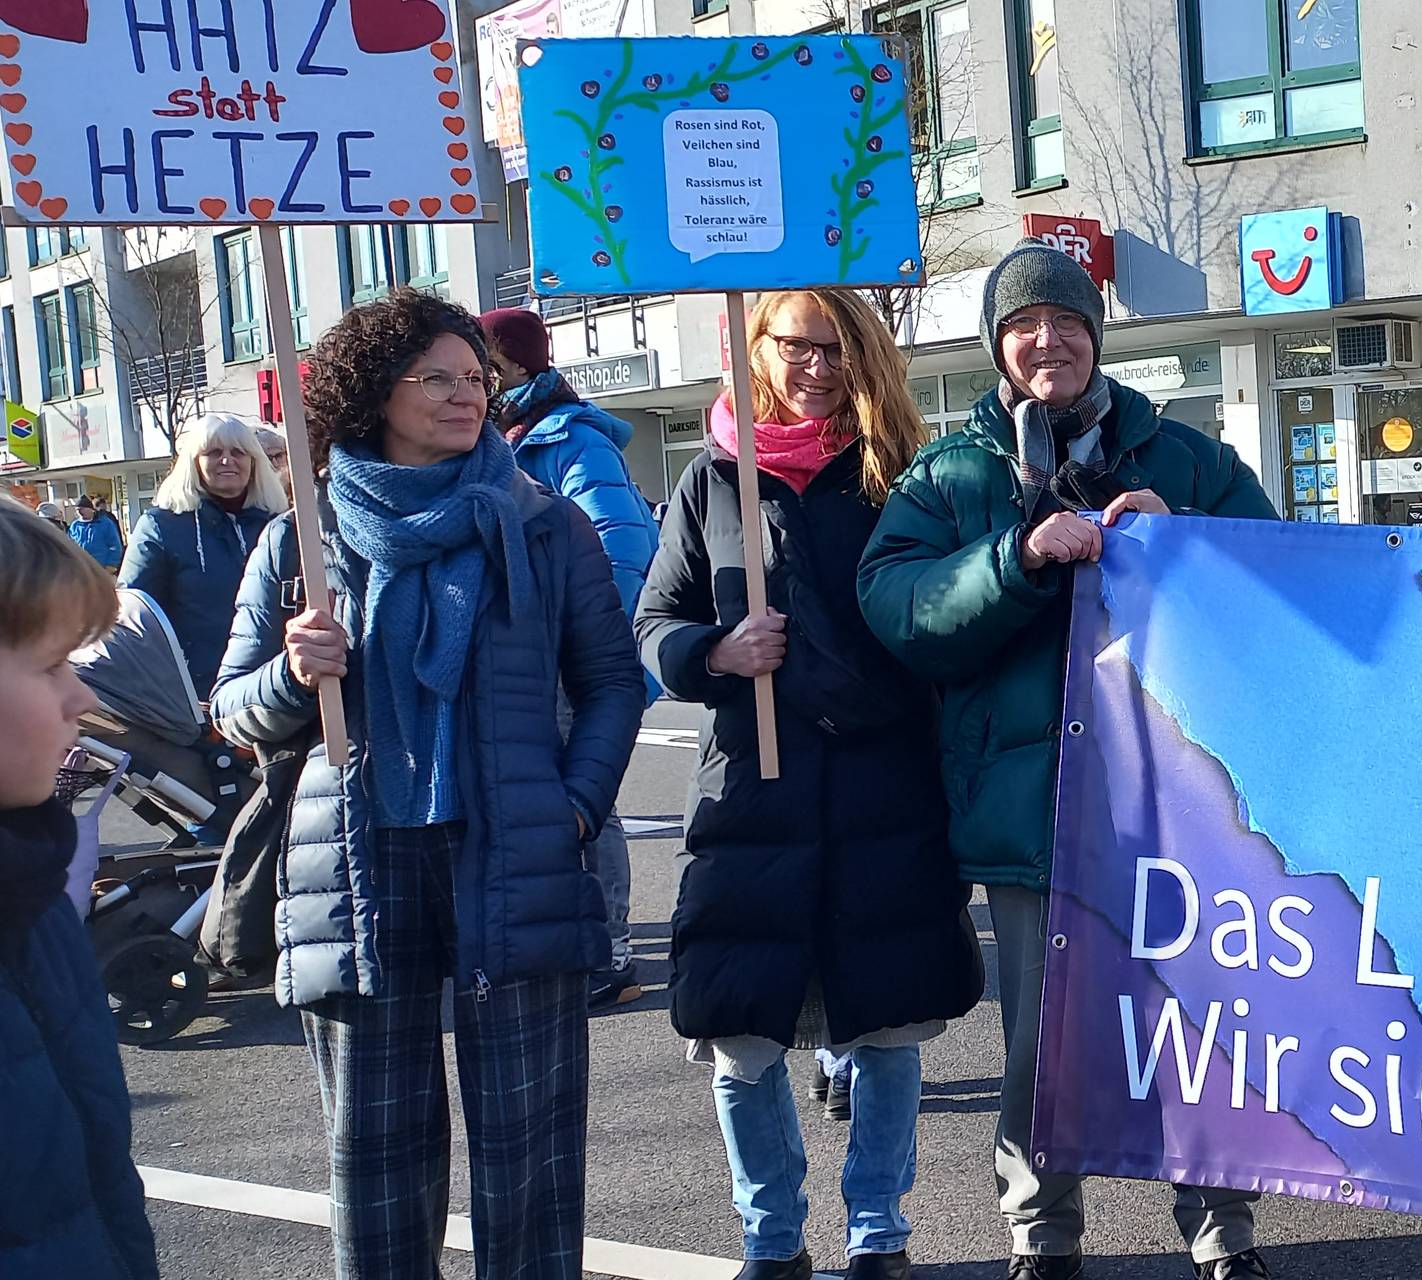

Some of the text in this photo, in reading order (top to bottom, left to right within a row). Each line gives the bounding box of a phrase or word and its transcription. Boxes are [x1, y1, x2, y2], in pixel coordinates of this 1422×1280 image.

[152, 76, 286, 123] statt
[675, 119, 765, 131] Rosen sind Rot,
[682, 139, 760, 150] Veilchen sind
[708, 157, 737, 169] Blau,
[86, 125, 383, 215] HETZE
[685, 177, 763, 188] Rassismus ist
[700, 195, 750, 207] hässlich,
[684, 214, 768, 225] Toleranz wäre
[706, 231, 748, 243] schlau!
[1041, 231, 1092, 264] DER
[668, 420, 700, 434] DARKSIDE
[1130, 856, 1314, 980] Das
[1118, 994, 1298, 1113] Wir
